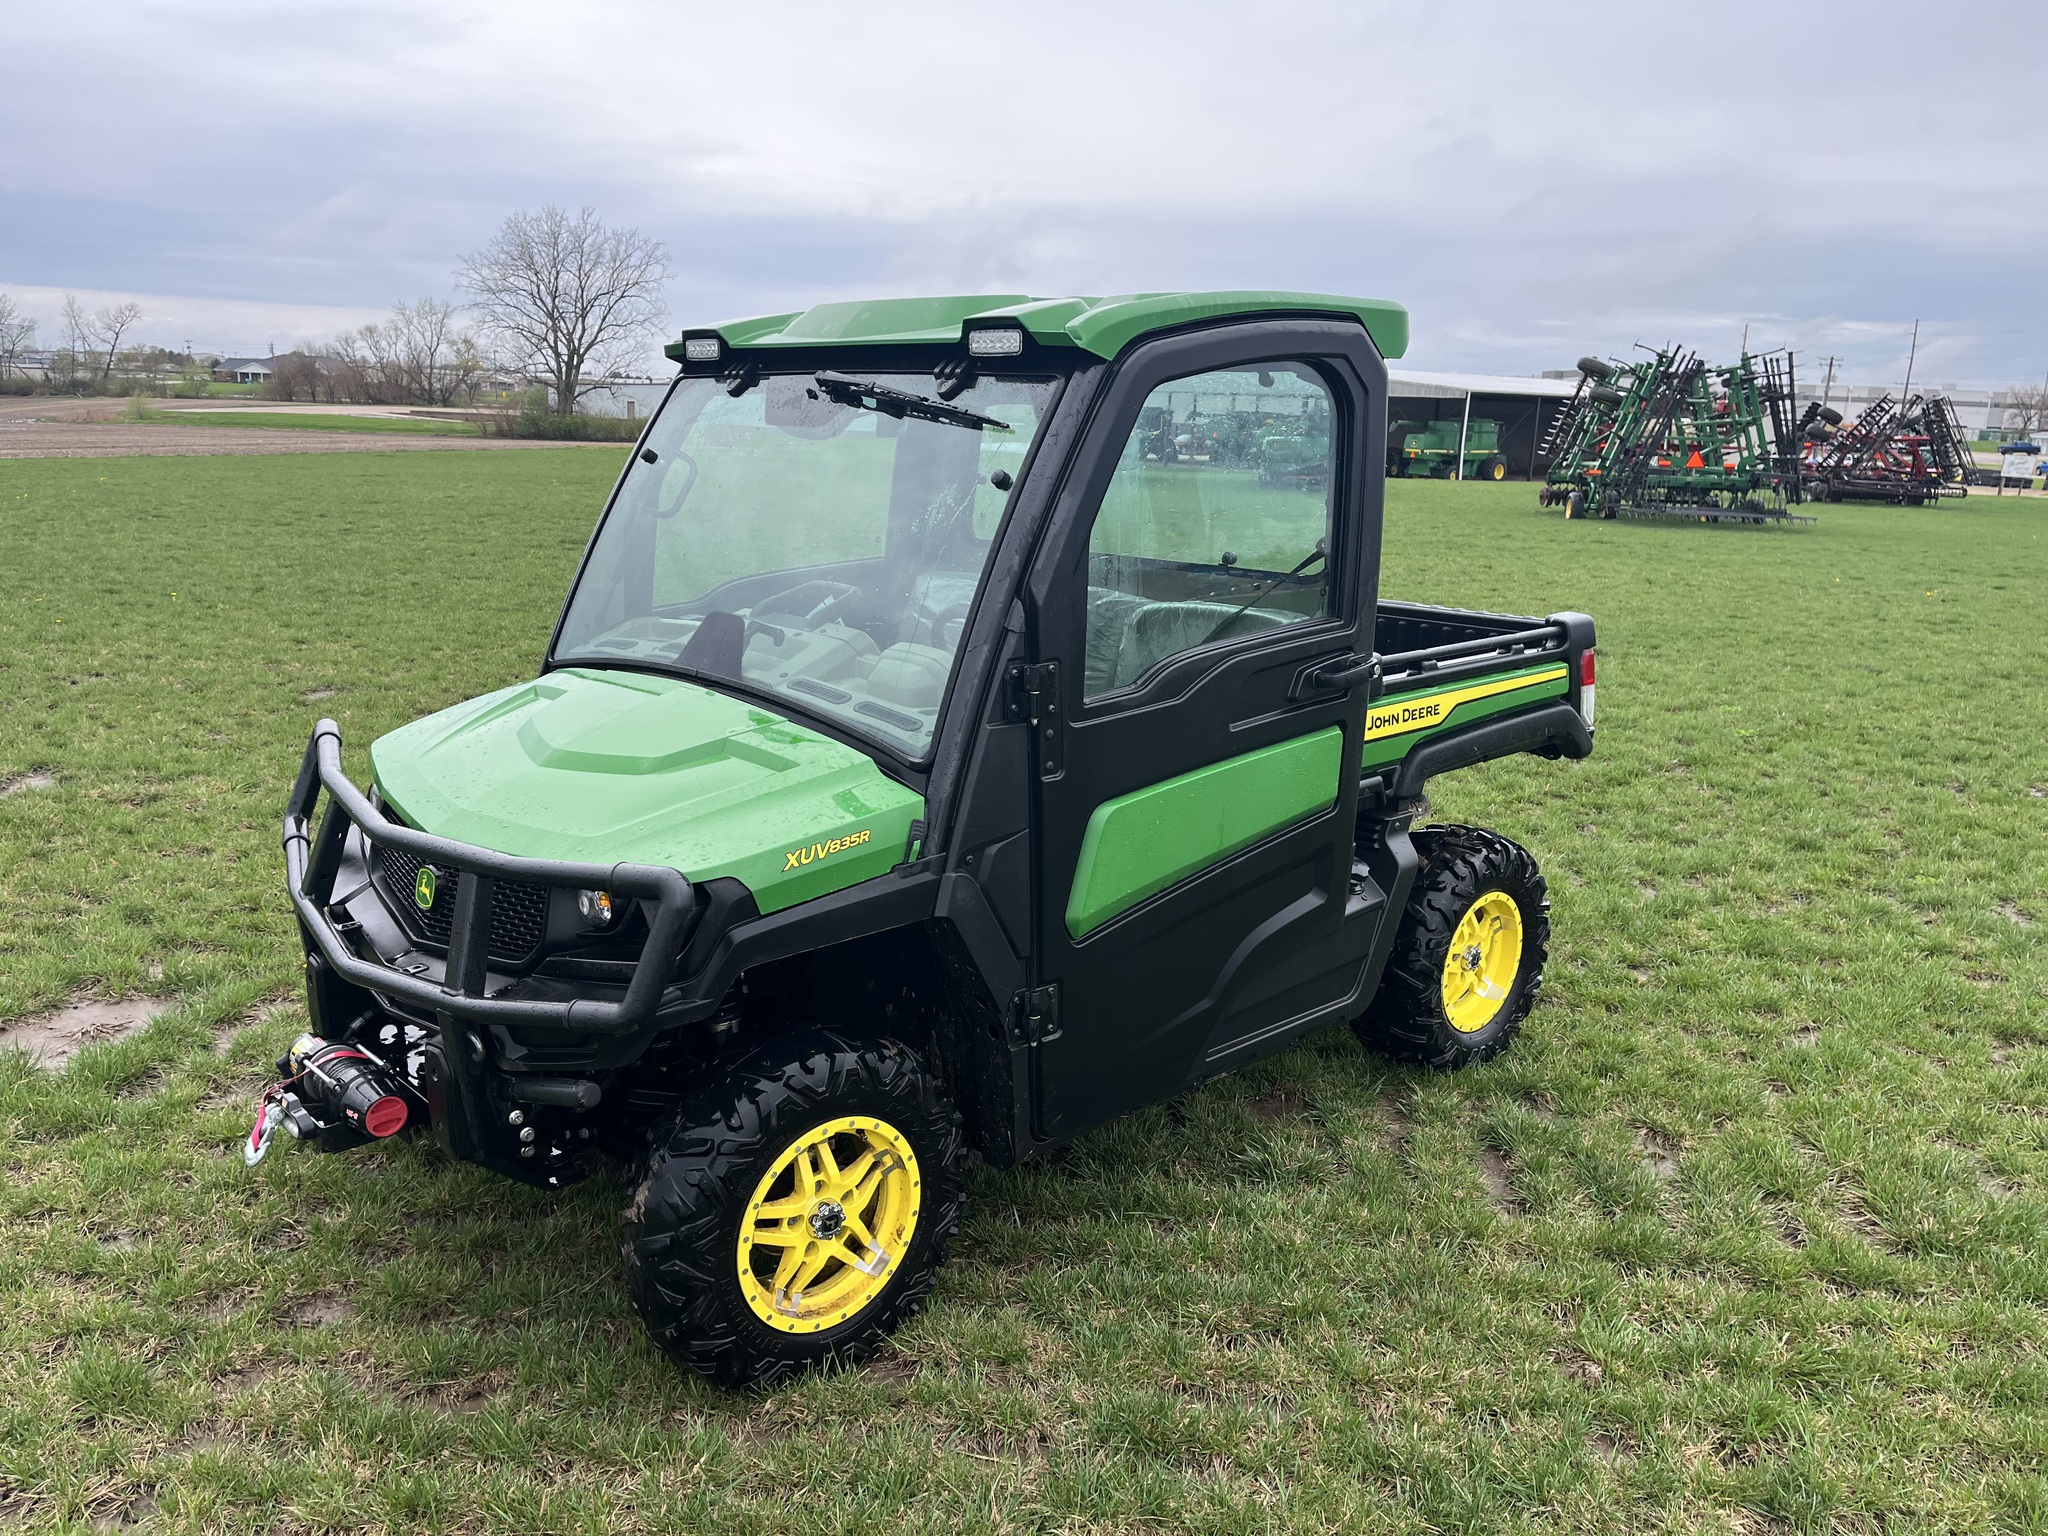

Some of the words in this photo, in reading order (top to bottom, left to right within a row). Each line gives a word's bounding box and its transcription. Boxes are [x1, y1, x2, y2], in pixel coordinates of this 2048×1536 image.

[1367, 712, 1400, 731] JOHN
[1402, 704, 1440, 723] DEERE
[782, 829, 871, 872] XUV835R
